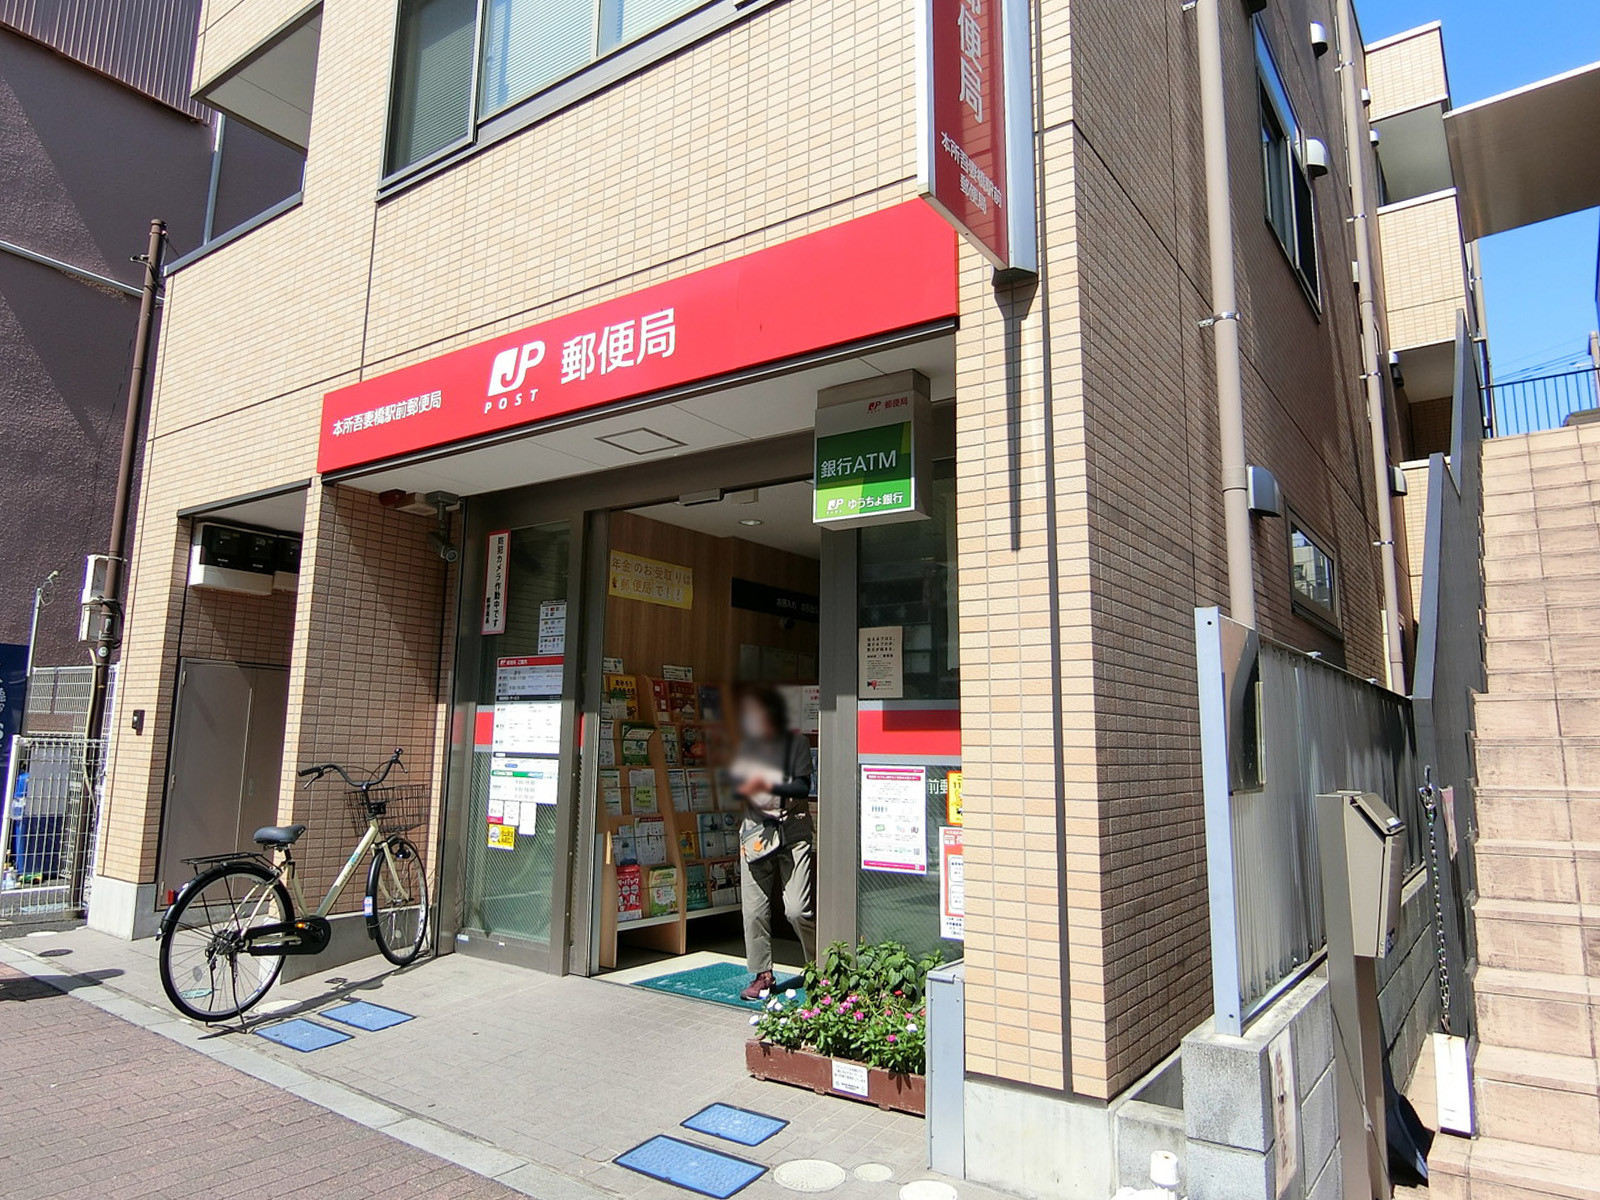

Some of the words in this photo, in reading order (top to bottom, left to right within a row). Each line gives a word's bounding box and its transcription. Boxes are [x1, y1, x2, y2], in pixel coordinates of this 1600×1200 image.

[959, 173, 988, 215] 郵便局
[560, 307, 676, 385] 郵便局
[332, 390, 443, 437] 本所吾妻橋駅前郵便局
[484, 388, 539, 415] POST
[820, 450, 897, 478] 銀行ATM
[847, 491, 904, 510] ゆうちょ銀行
[611, 556, 692, 586] 年金のお受取りは
